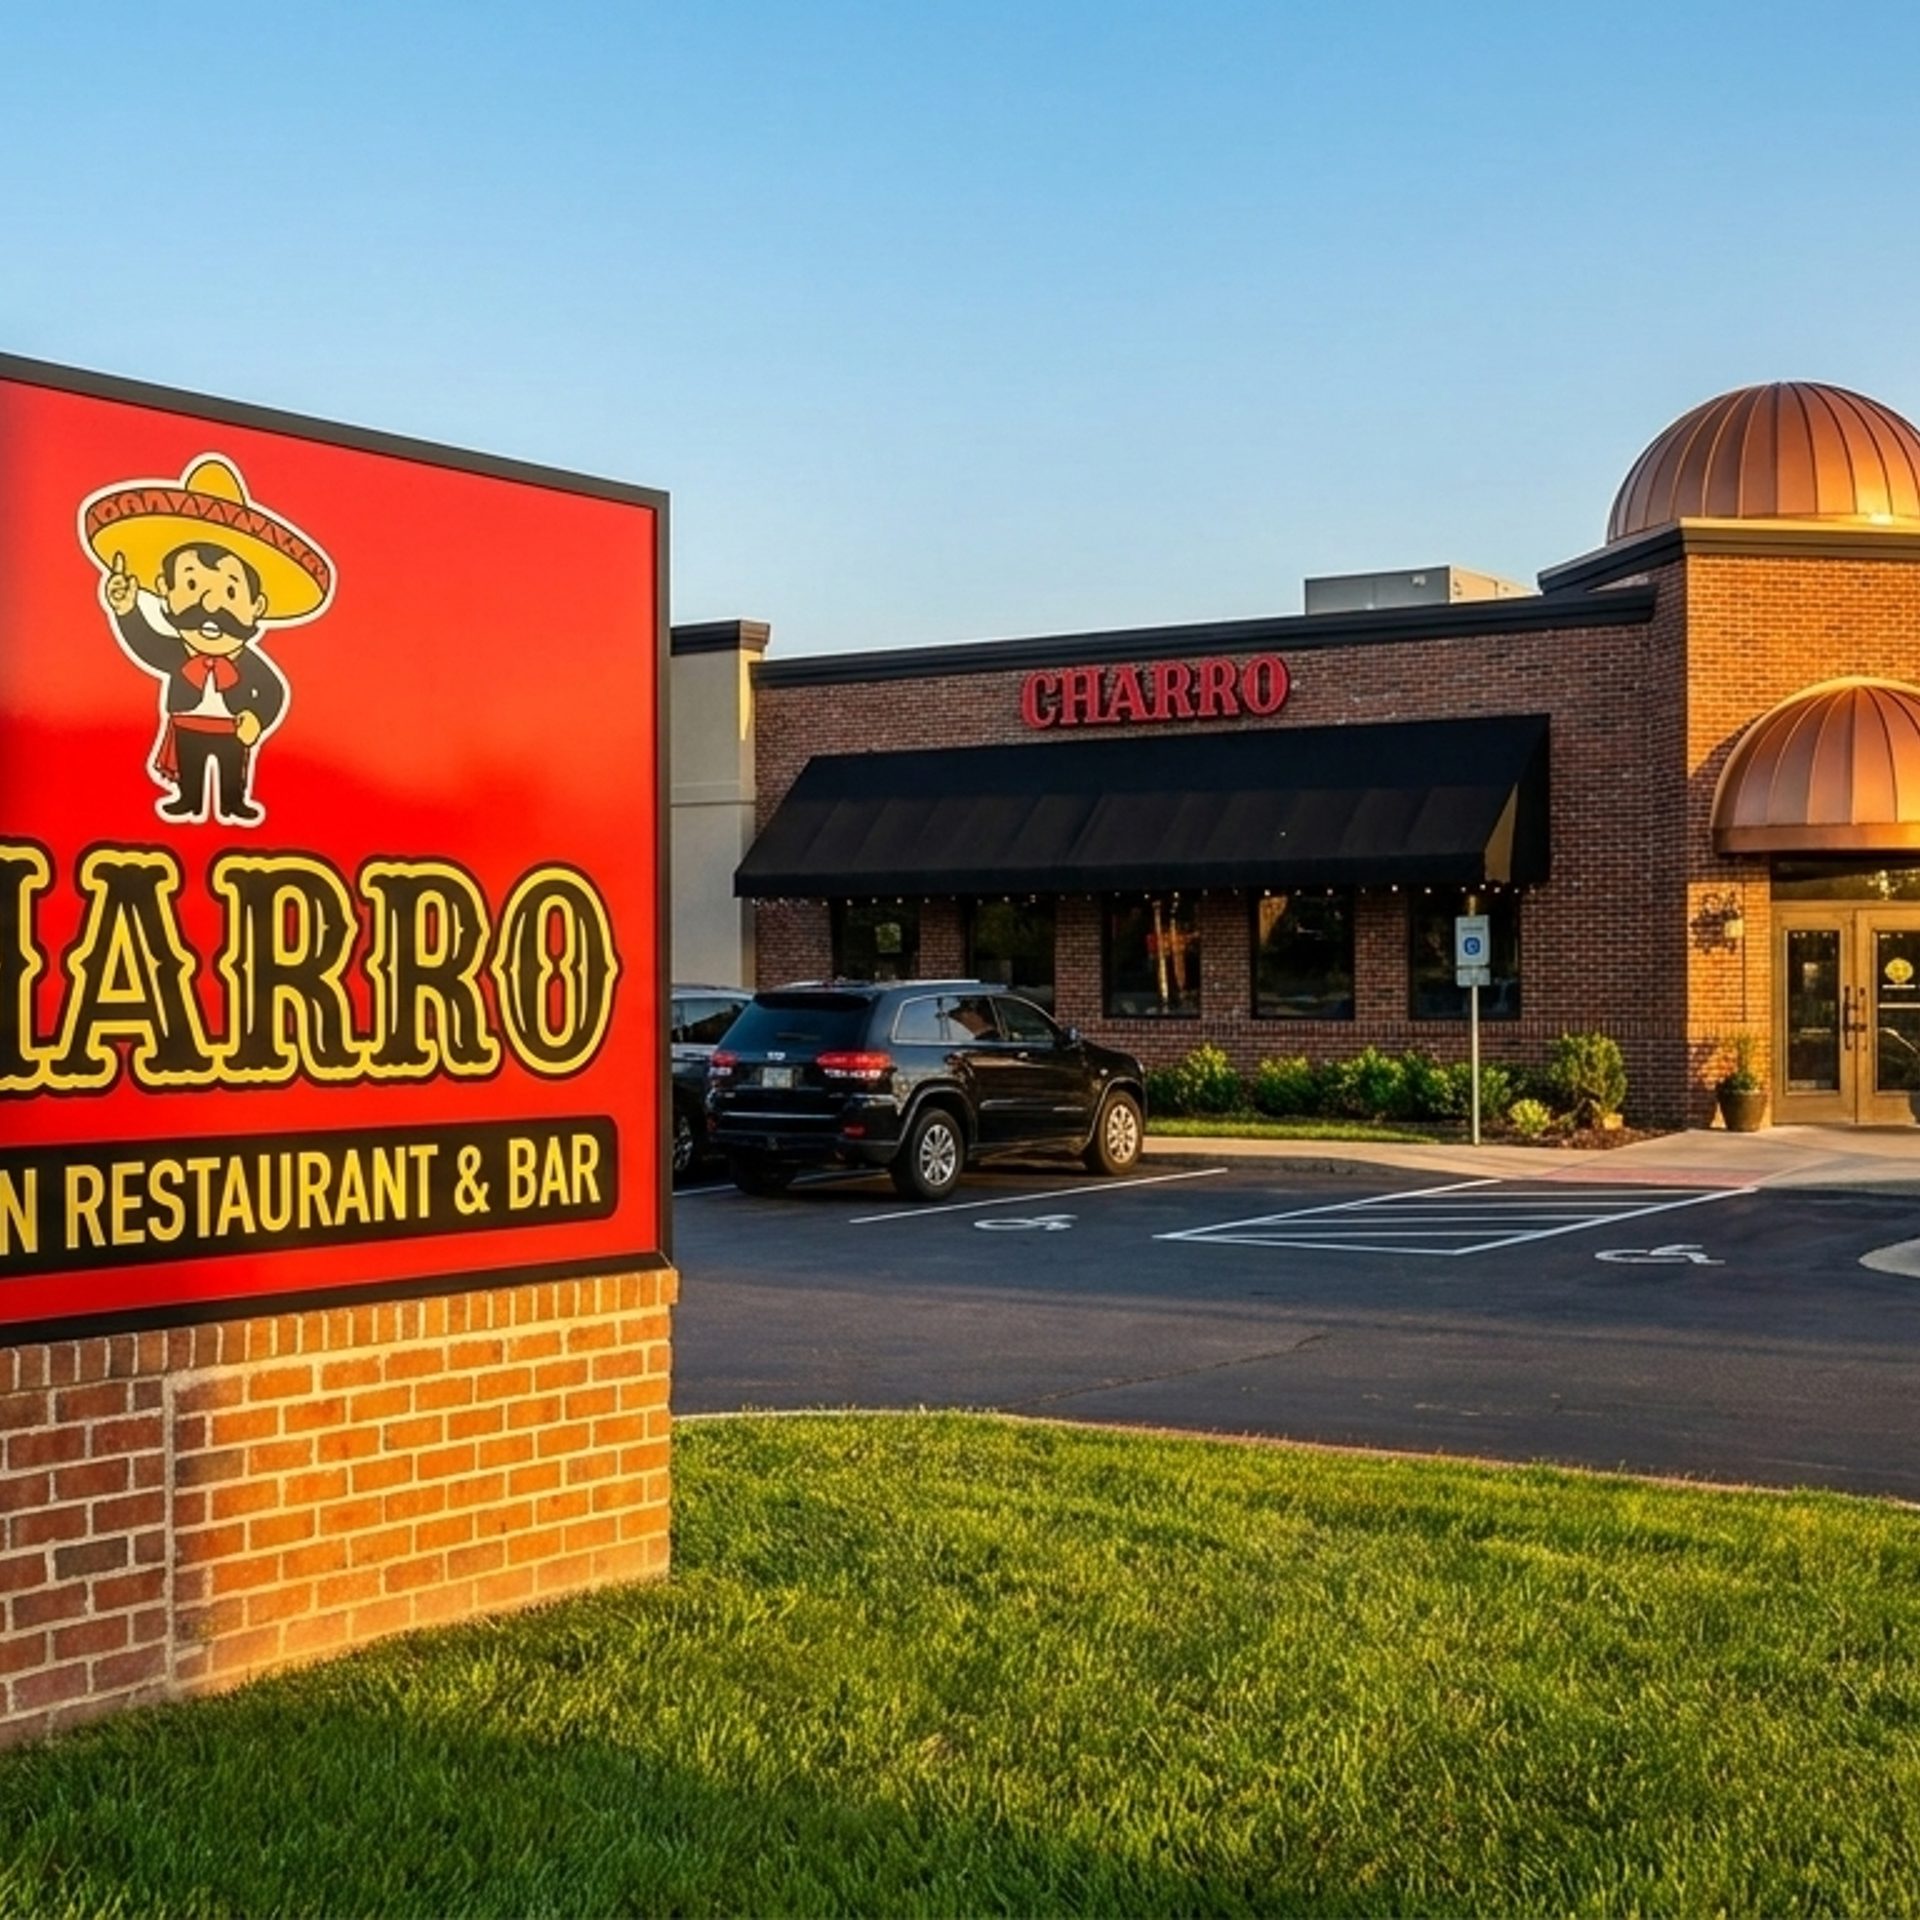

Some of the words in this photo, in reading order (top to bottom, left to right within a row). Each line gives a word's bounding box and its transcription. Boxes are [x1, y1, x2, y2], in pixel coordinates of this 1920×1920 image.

[1020, 652, 1289, 729] CHARRO
[65, 1144, 438, 1249] RESTAURANT
[455, 1145, 490, 1214] &
[509, 1134, 600, 1210] BAR
